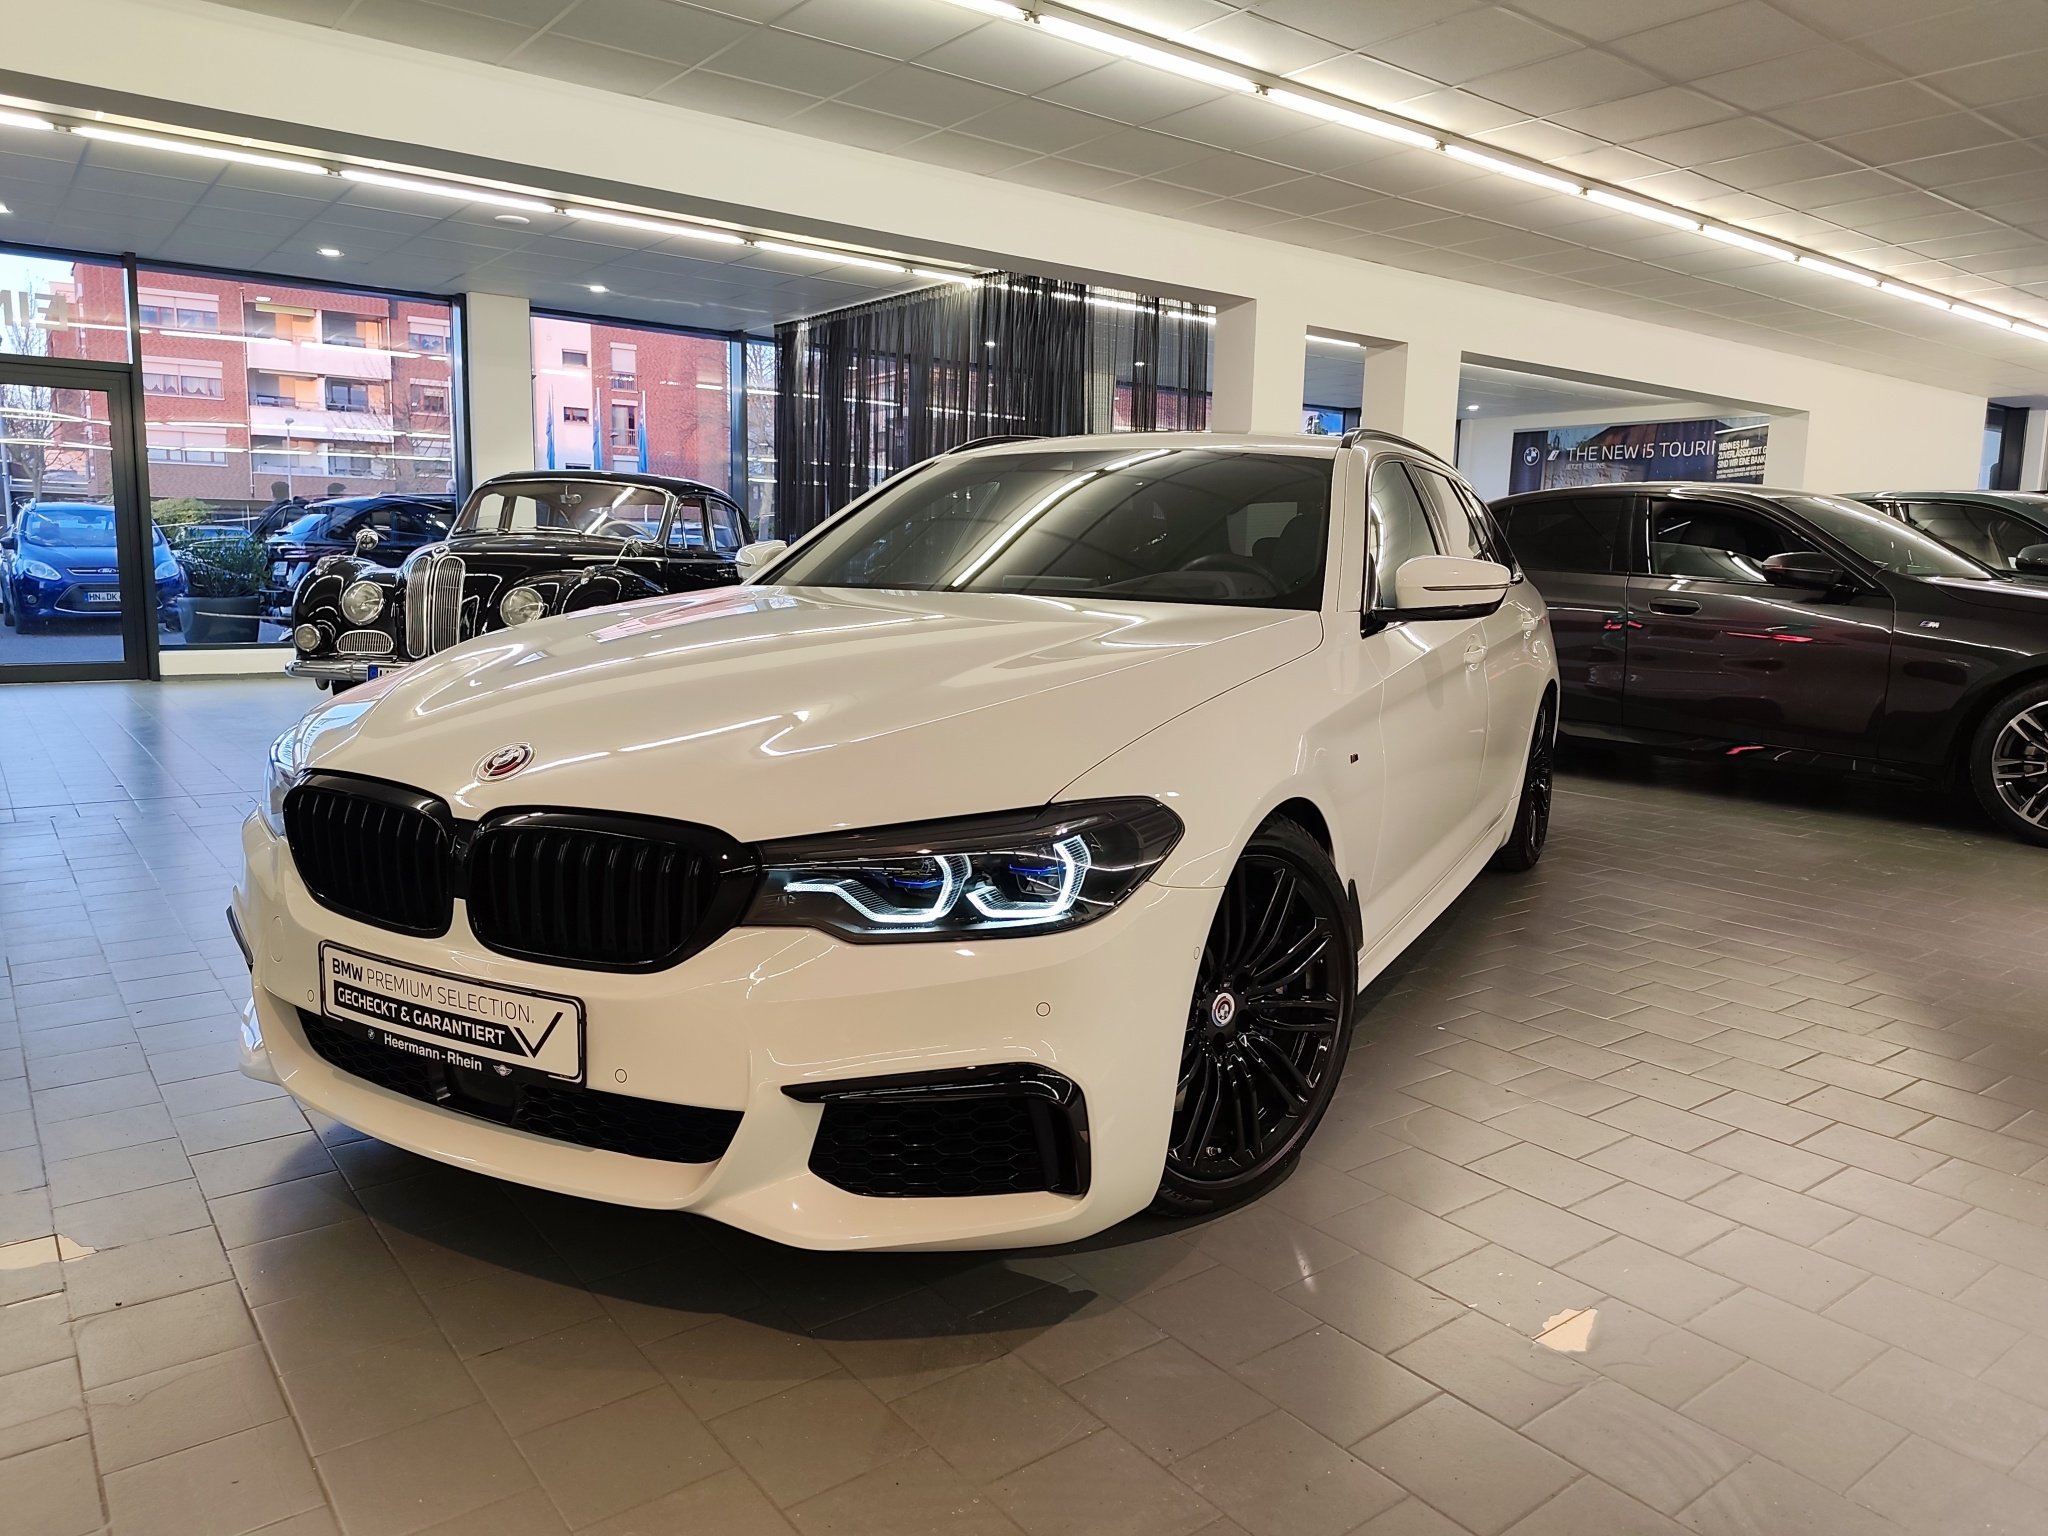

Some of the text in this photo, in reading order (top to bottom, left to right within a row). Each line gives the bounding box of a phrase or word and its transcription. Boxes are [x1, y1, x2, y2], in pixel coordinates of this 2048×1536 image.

[1567, 446, 1598, 462] THE
[1601, 444, 1639, 461] NEW
[1642, 442, 1655, 459] i5
[1733, 441, 1740, 449] ES
[1741, 439, 1749, 448] UM
[89, 593, 100, 601] HN
[332, 957, 535, 1024] BMW PREMIUM SELECTION.
[338, 987, 506, 1045] GECHECKT & GARANTIERT
